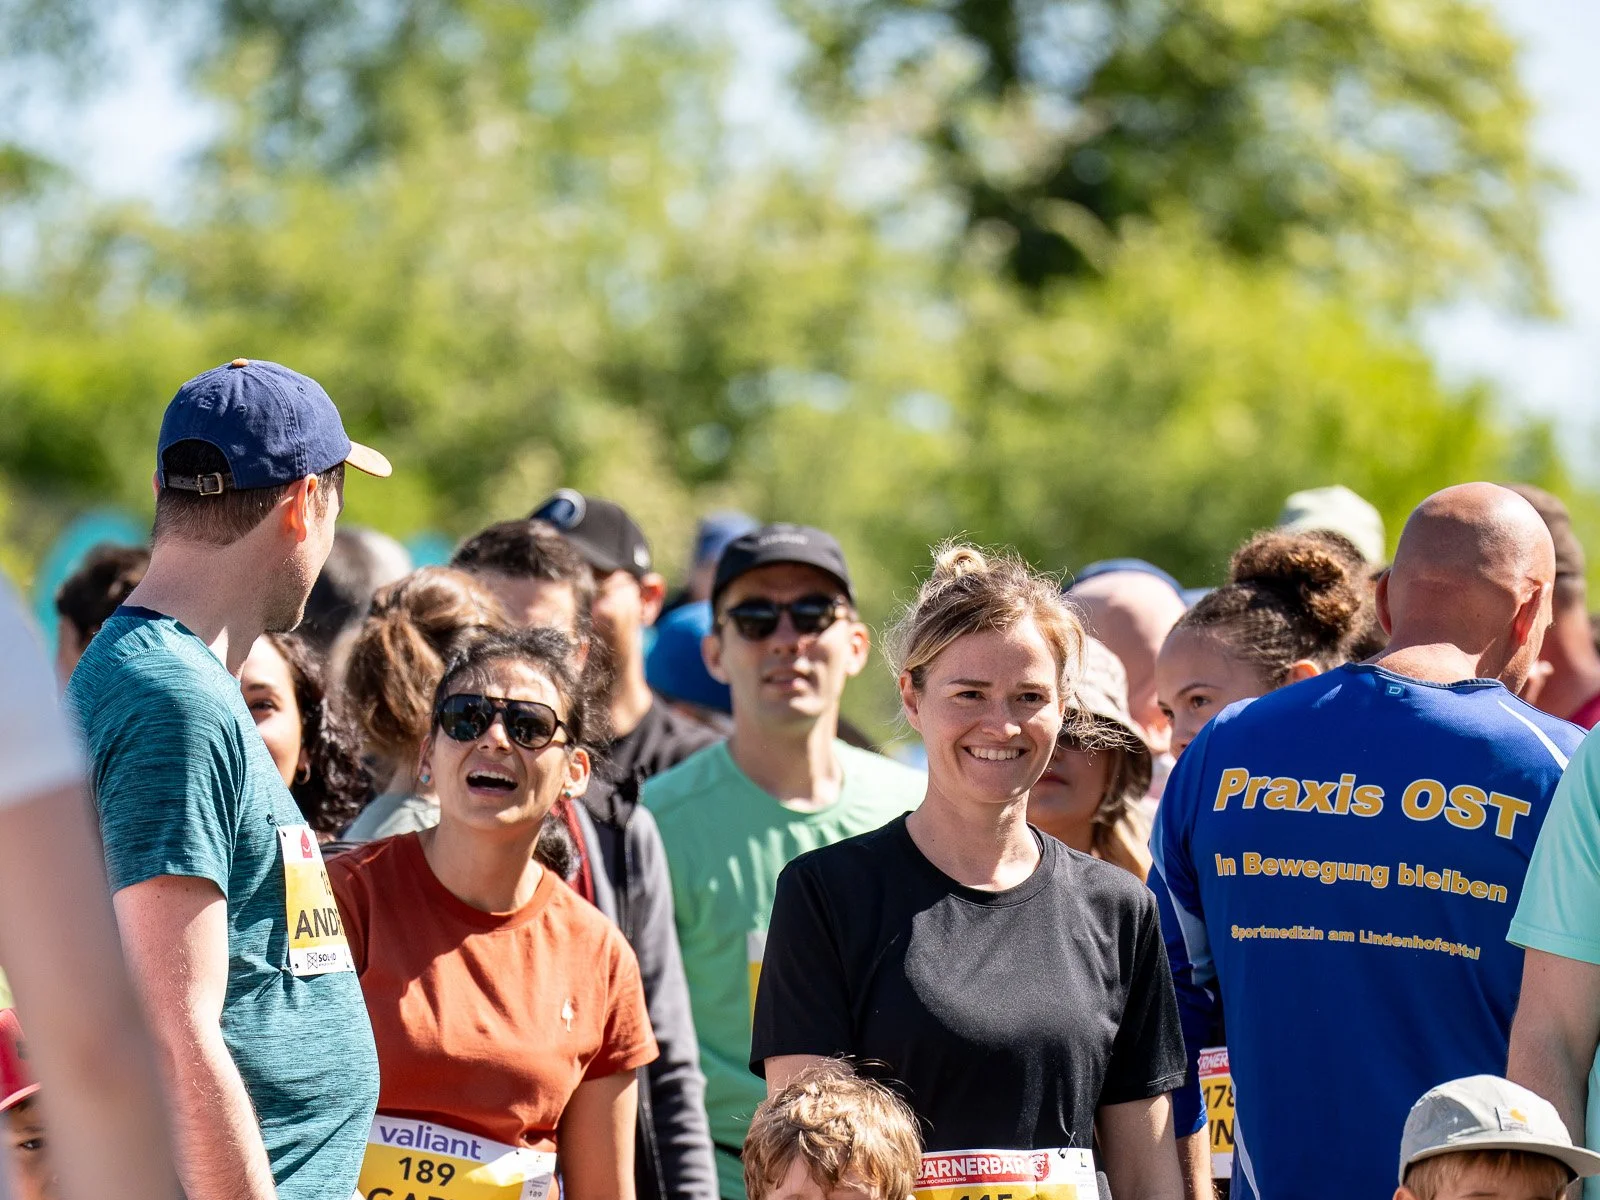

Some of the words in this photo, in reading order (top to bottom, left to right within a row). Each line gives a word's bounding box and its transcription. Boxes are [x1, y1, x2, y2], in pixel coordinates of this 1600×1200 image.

[1213, 767, 1385, 817] Praxis
[1401, 778, 1531, 840] OST
[1214, 852, 1236, 876] In
[1242, 851, 1390, 888] Bewegung
[1397, 863, 1508, 903] bleiben
[1231, 924, 1323, 941] Sportmedizin
[1328, 930, 1354, 941] am
[1359, 929, 1480, 960] Lindenhofspital
[379, 1124, 482, 1161] valiant
[398, 1156, 456, 1187] 189
